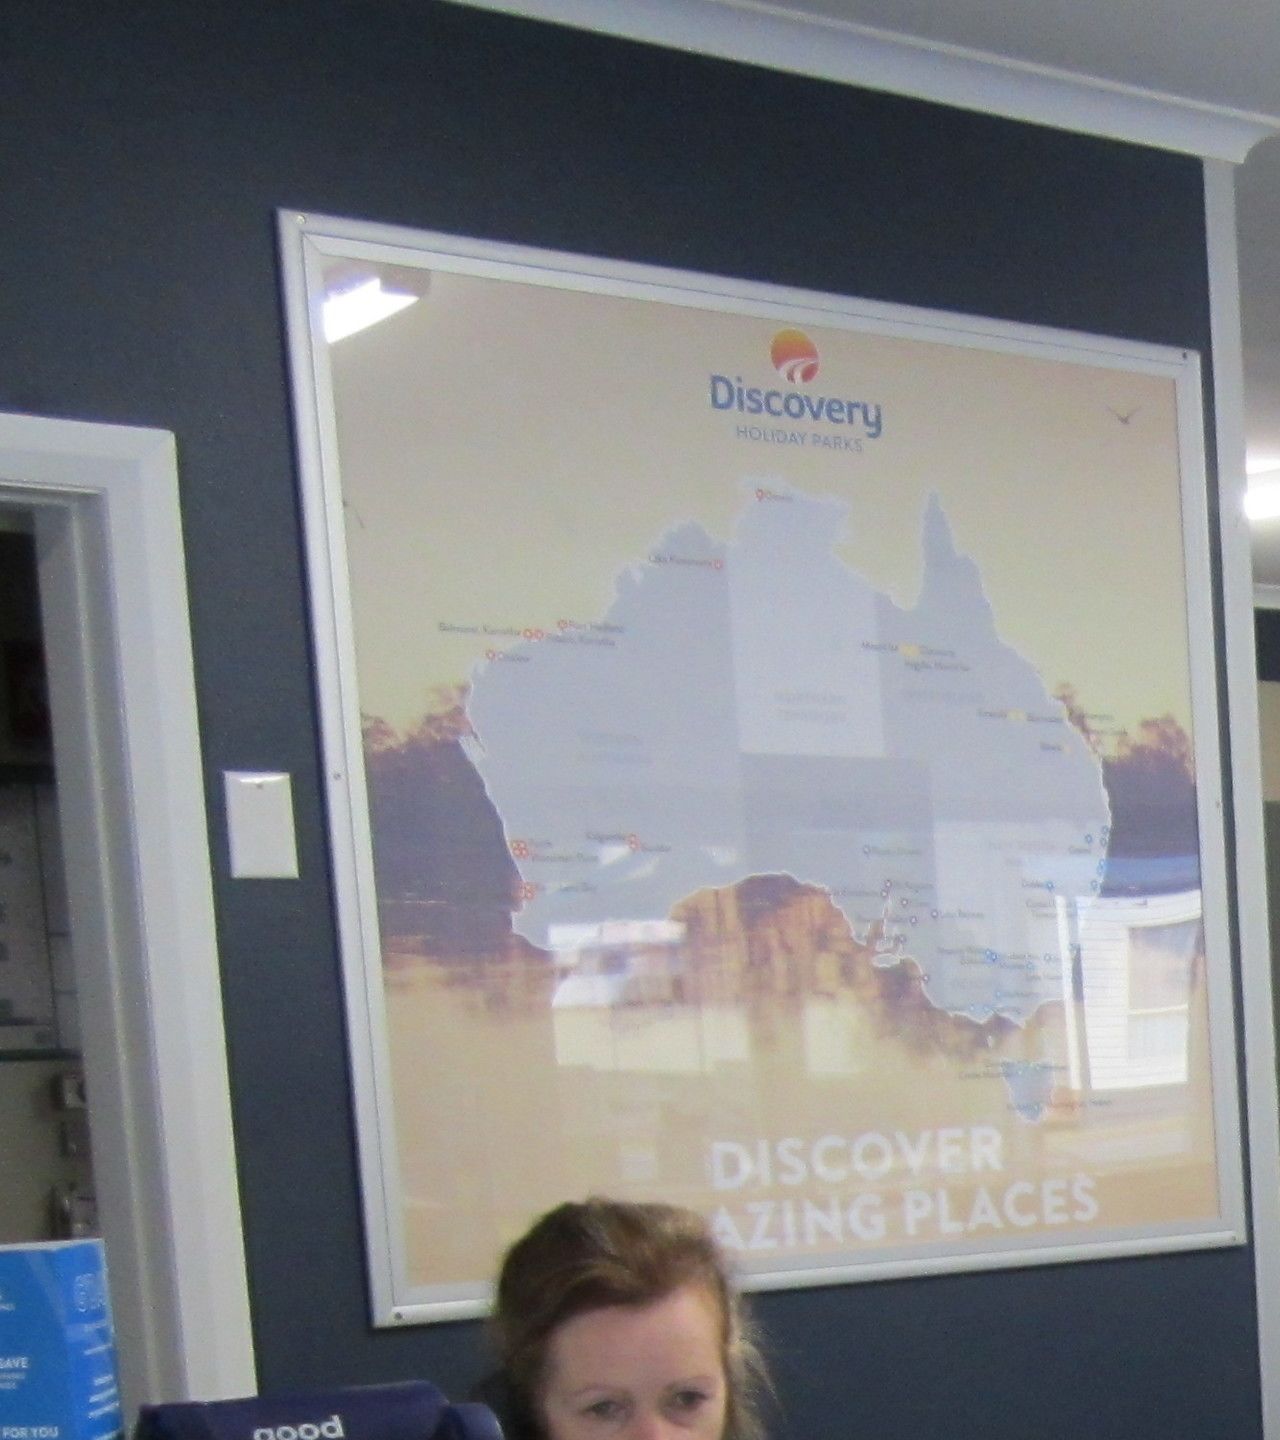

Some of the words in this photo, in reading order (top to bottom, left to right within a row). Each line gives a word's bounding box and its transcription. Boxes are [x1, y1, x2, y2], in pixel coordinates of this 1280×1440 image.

[709, 373, 883, 439] Discovery
[736, 425, 806, 445] HOLIDAY
[812, 433, 863, 452] PARKS
[709, 1126, 1004, 1191] DISCOVER
[710, 1194, 889, 1251] AZING
[903, 1171, 1098, 1235] PLACES
[2, 1427, 28, 1439] FOR
[32, 1426, 59, 1439] YOU
